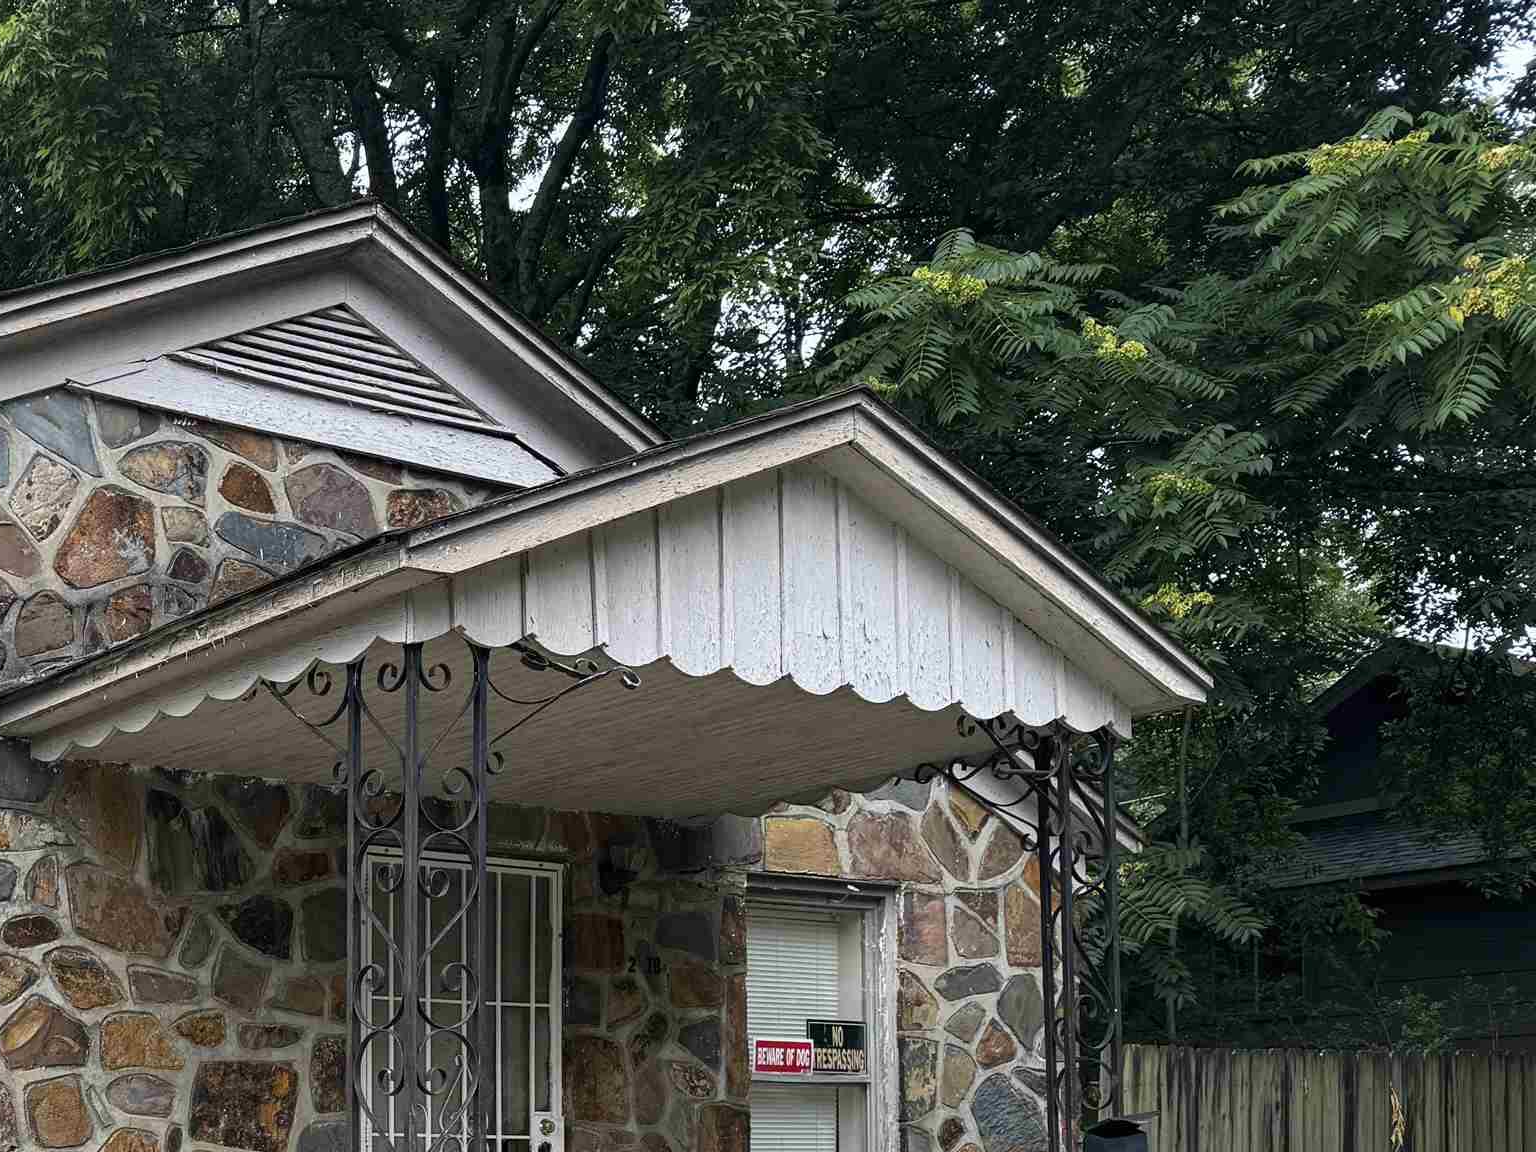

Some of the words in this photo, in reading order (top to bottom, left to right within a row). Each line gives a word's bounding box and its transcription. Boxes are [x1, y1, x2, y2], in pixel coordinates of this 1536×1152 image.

[832, 1026, 844, 1048] NO
[757, 1047, 784, 1066] BEWARE
[786, 1048, 795, 1066] OF
[796, 1048, 810, 1068] DOG
